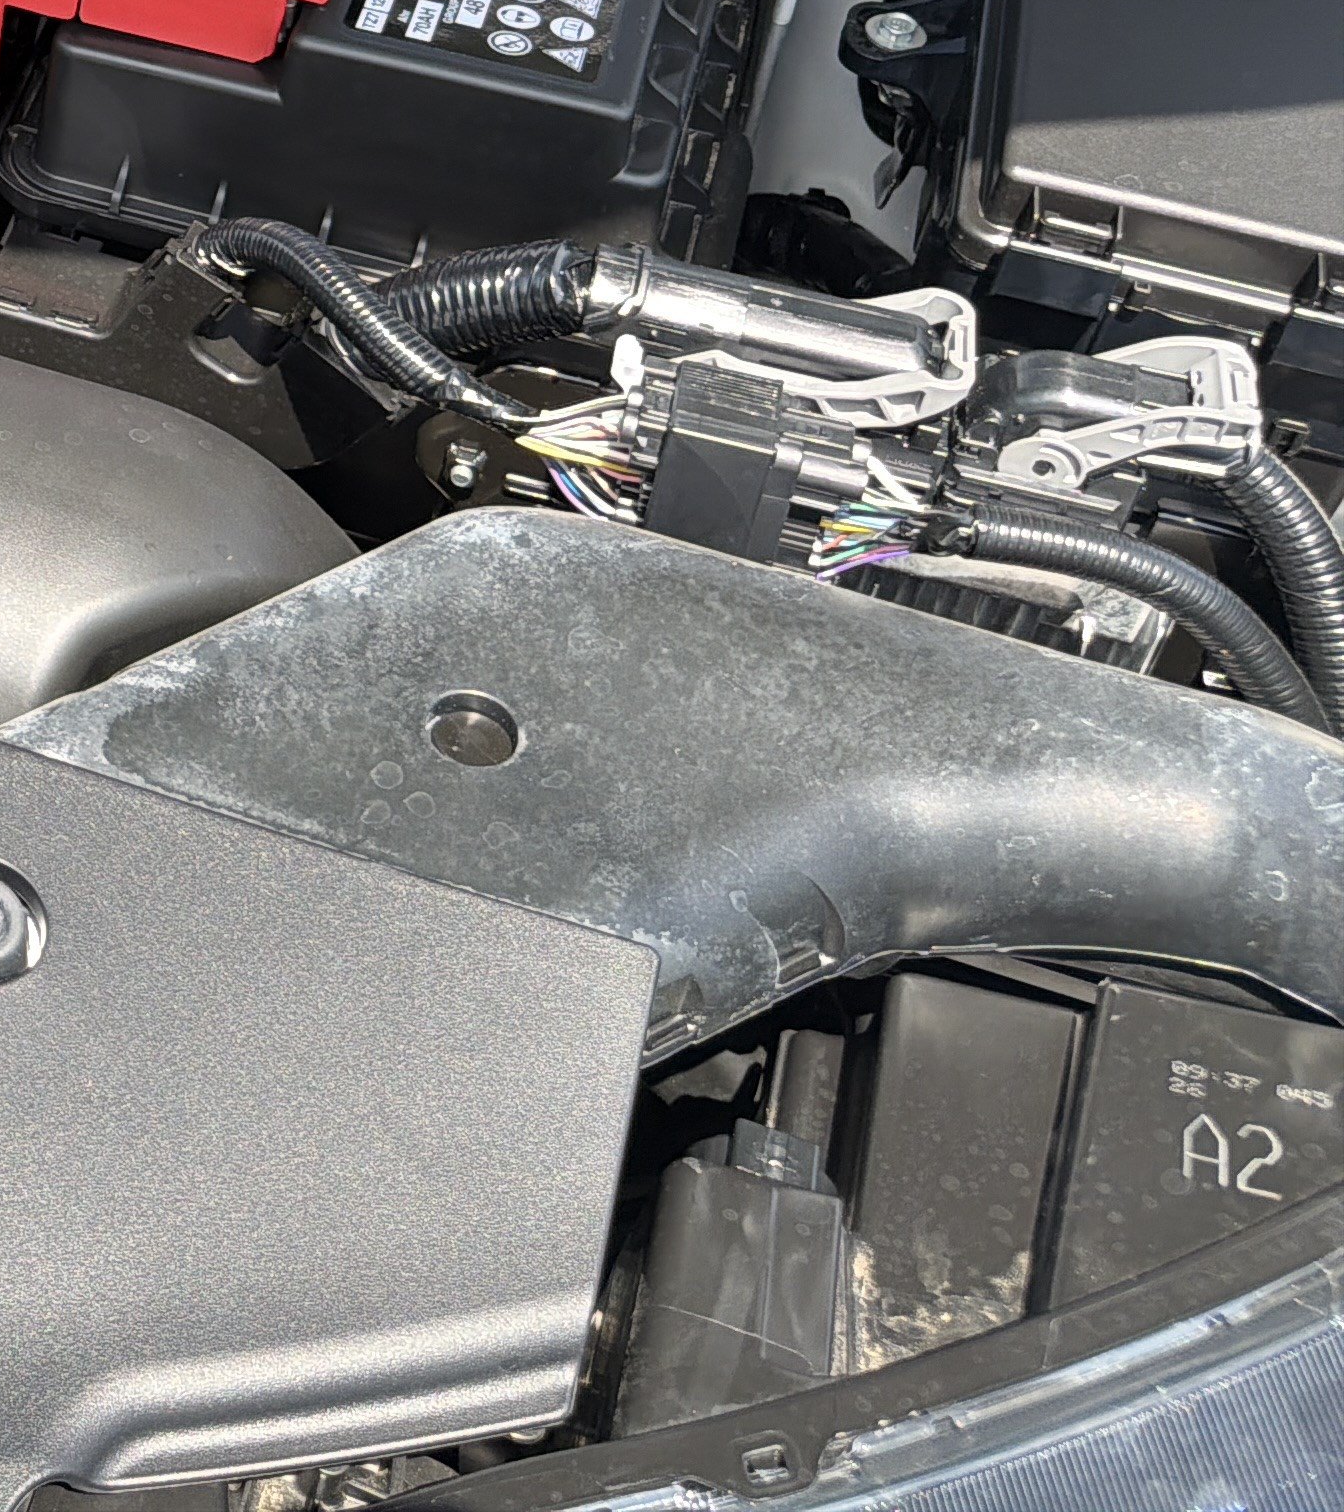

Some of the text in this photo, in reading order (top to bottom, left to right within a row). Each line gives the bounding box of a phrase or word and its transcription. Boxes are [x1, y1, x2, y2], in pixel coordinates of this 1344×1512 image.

[412, 6, 437, 35] 70AH
[463, 0, 486, 16] 48
[1181, 1113, 1285, 1202] A2
